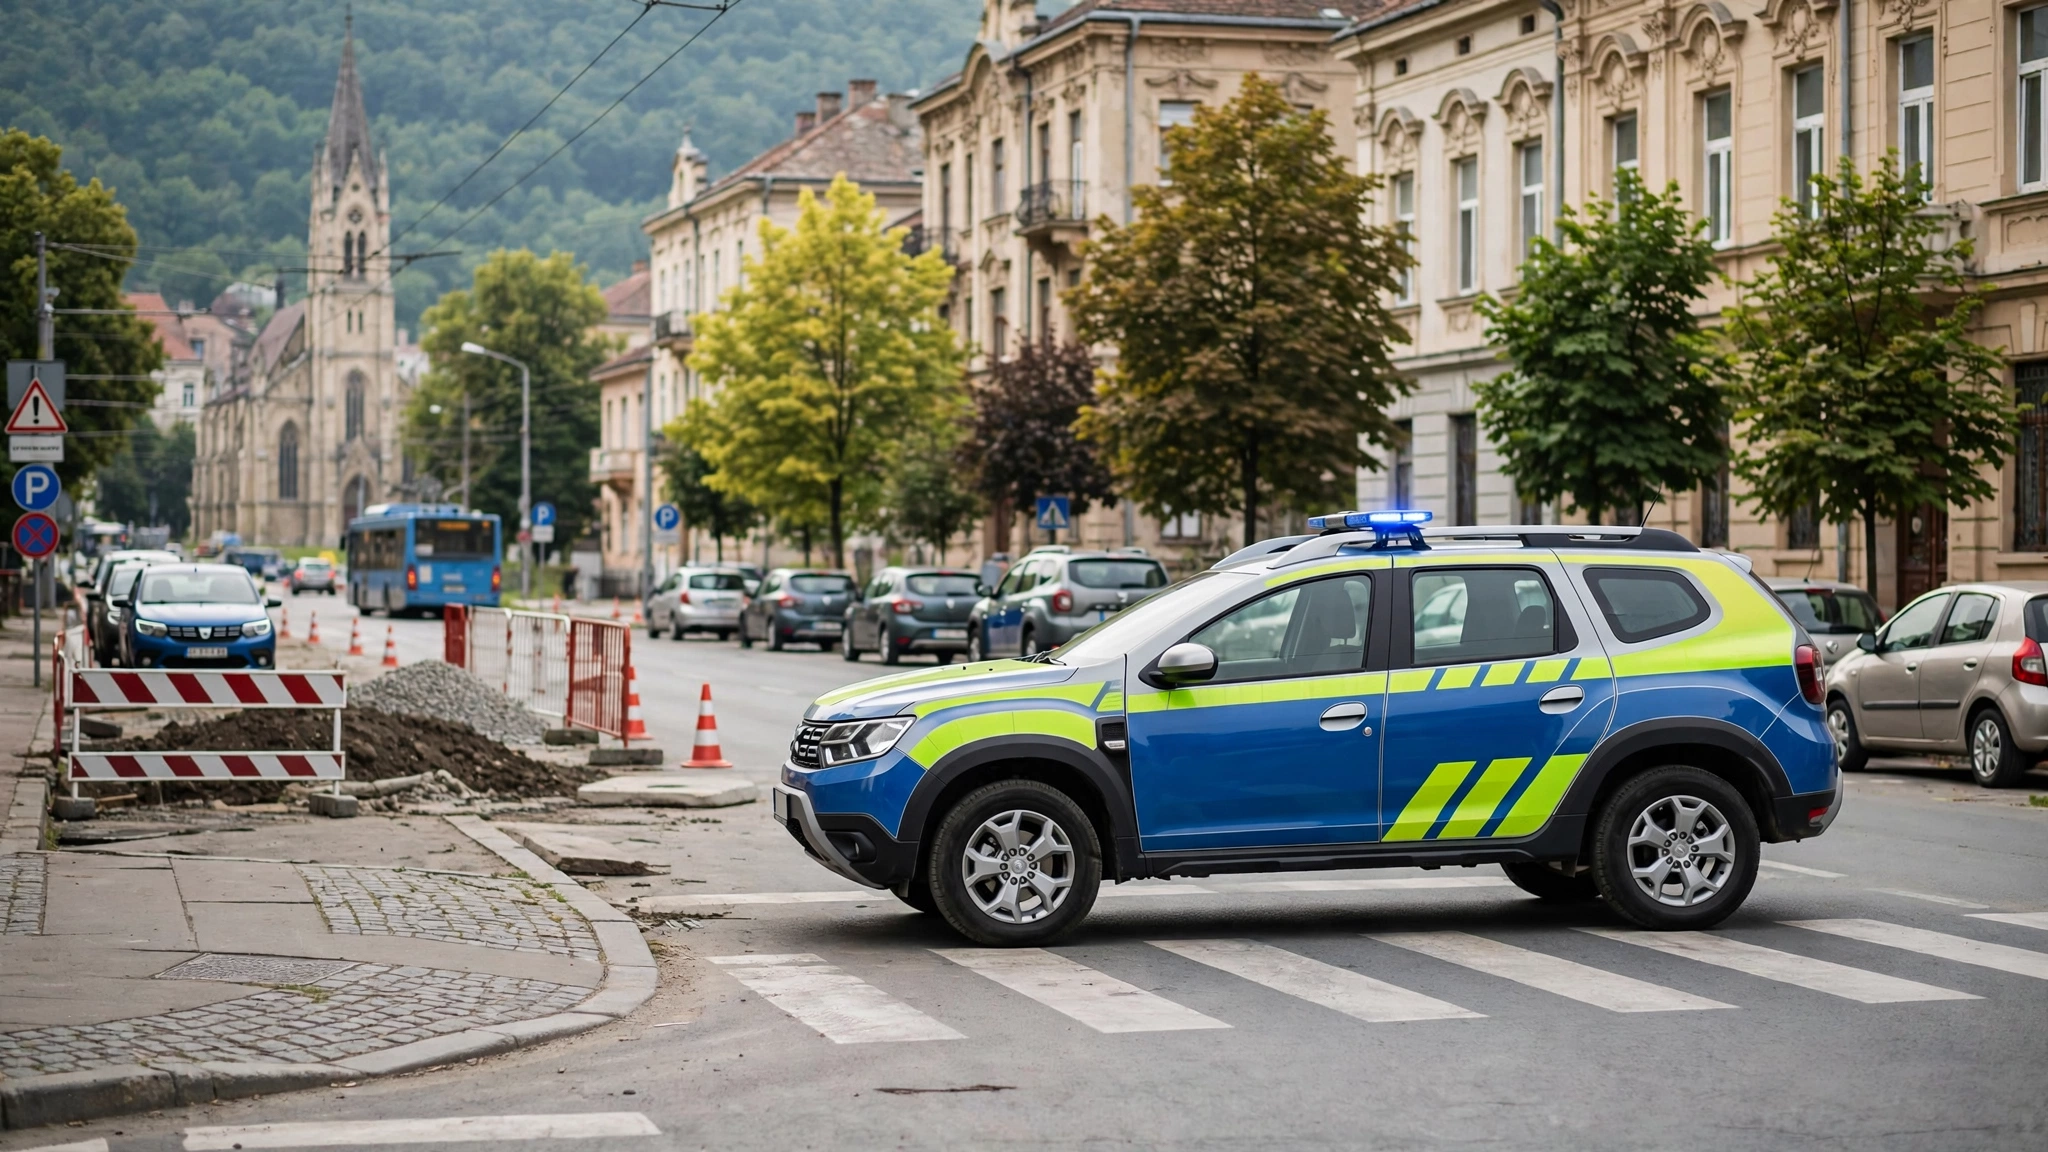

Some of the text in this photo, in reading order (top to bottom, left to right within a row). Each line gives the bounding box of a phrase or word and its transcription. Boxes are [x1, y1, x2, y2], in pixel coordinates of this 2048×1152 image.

[26, 471, 50, 505] P
[537, 505, 550, 524] P
[660, 508, 675, 527] P
